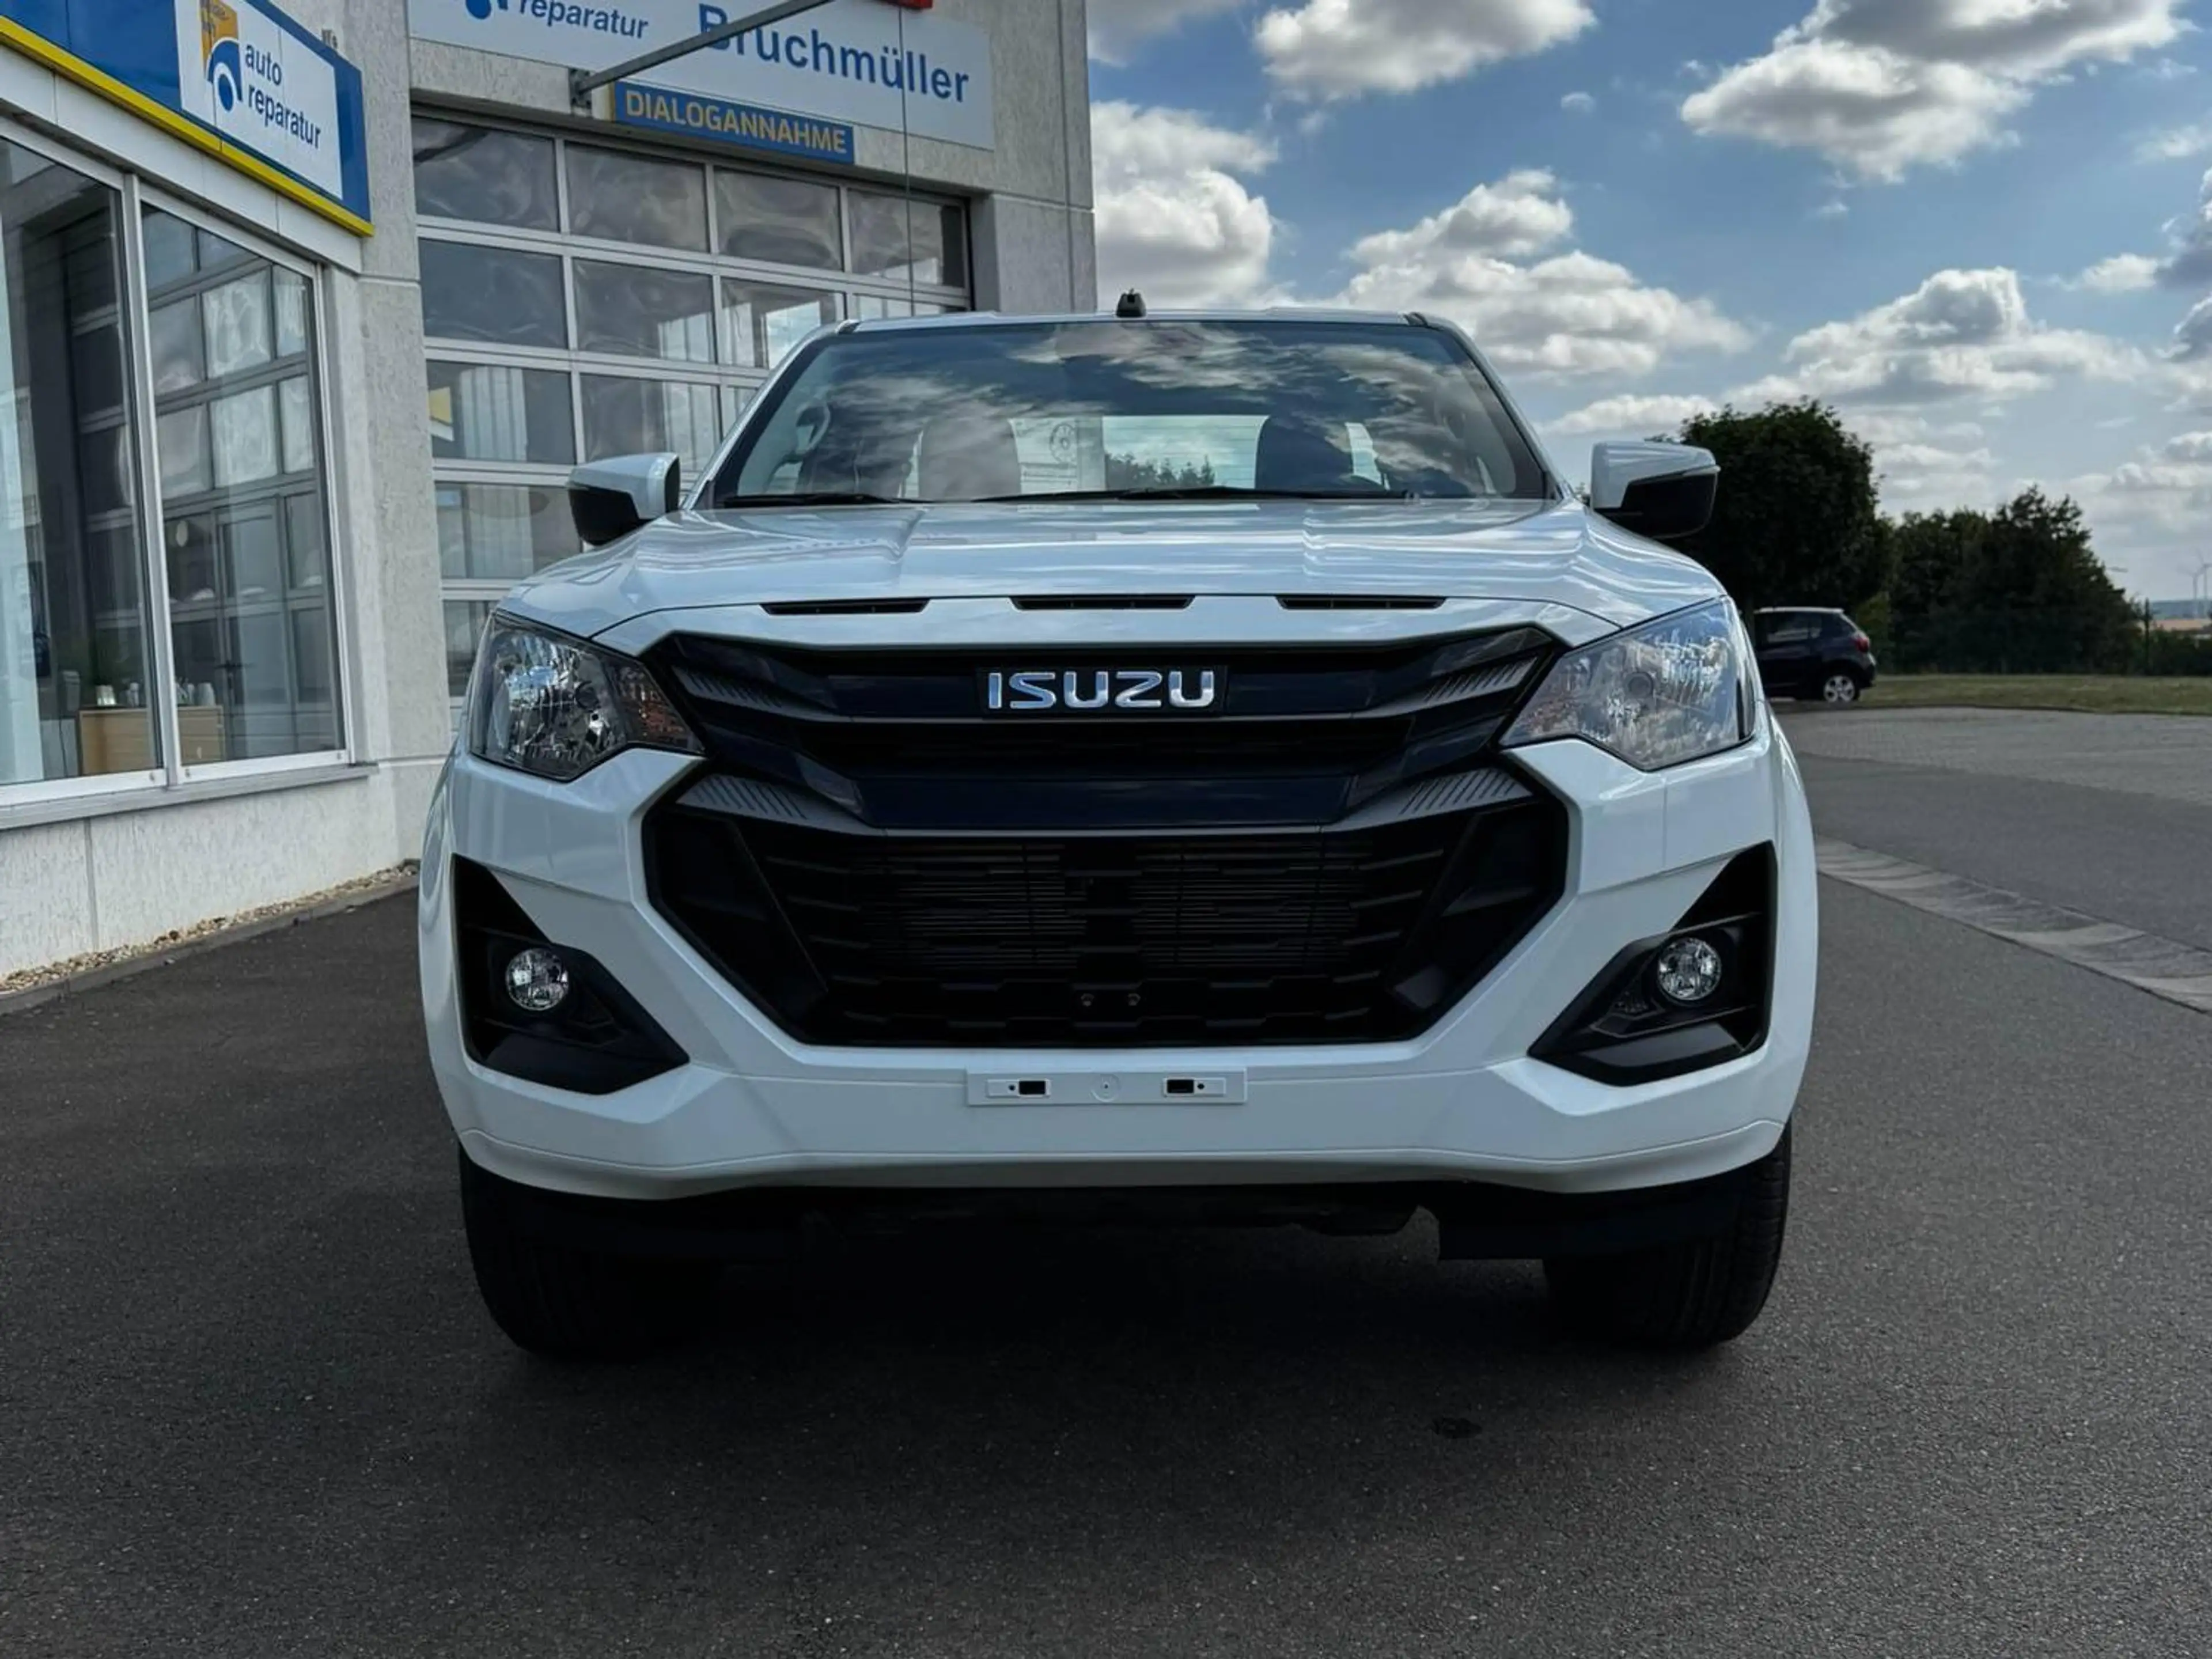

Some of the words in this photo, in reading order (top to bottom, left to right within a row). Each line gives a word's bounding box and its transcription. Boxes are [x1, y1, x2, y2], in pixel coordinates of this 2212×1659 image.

[519, 0, 649, 39] reparatur
[245, 44, 282, 86] auto
[248, 85, 321, 149] reparatur
[626, 90, 847, 154] DIALOGANNAHME
[988, 671, 1215, 709] ISUZU
